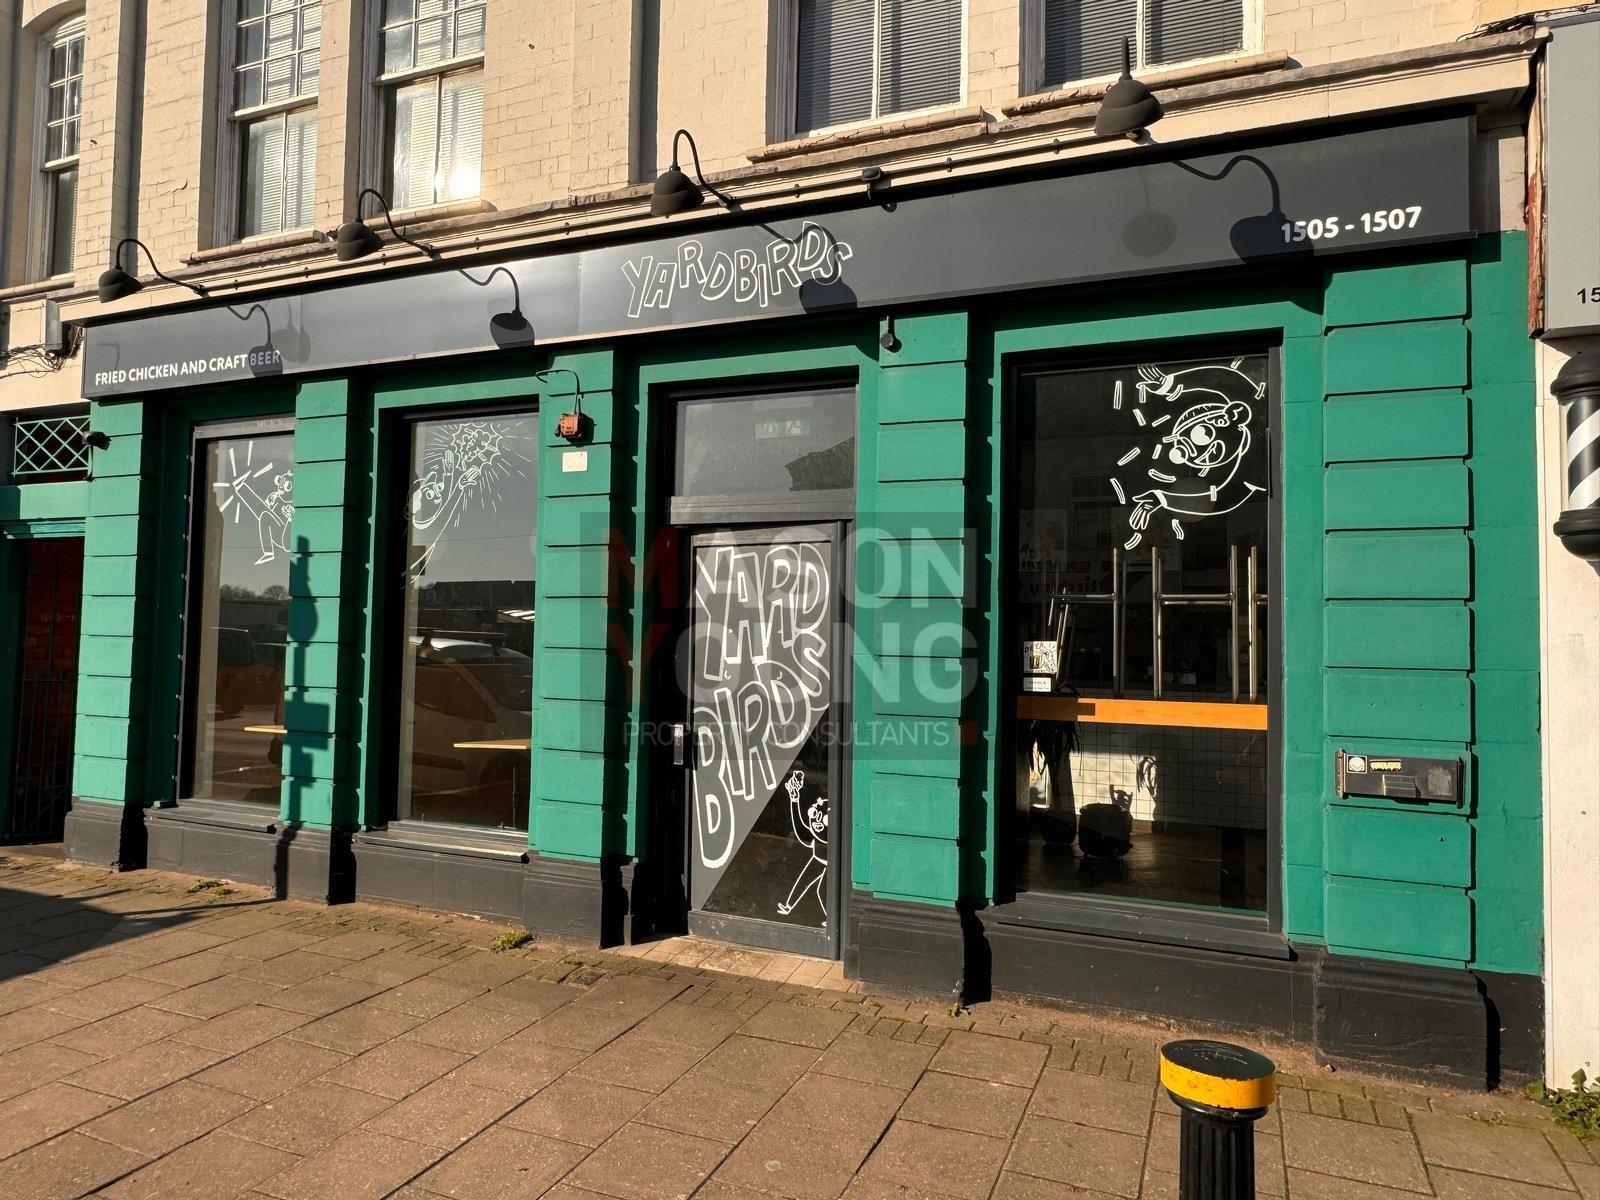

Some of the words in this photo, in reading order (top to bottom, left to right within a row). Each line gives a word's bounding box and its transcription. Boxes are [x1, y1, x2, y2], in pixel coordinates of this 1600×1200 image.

[621, 221, 853, 318] YARDBIRDS
[1281, 216, 1339, 244] 1505
[1360, 205, 1422, 234] 1507
[95, 369, 127, 386] FRIED
[128, 364, 178, 382] CHICKEN
[180, 359, 207, 376] AND
[209, 353, 248, 372] CRAFT
[249, 349, 281, 366] BEER
[695, 543, 830, 681] YARD
[693, 630, 831, 869] BIRDS
